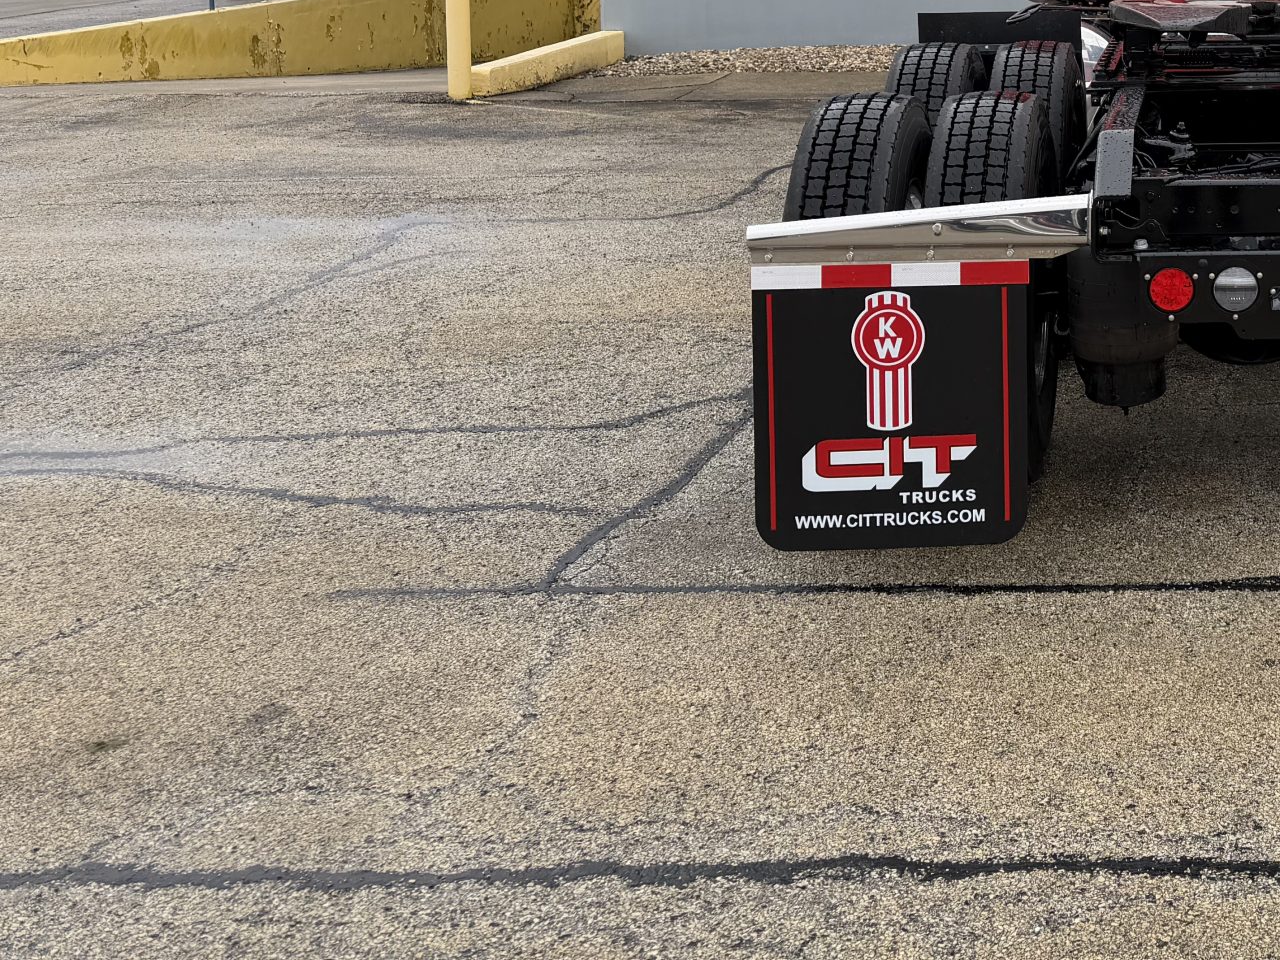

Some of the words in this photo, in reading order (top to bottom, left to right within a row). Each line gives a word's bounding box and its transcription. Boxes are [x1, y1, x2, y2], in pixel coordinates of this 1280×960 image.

[802, 434, 977, 492] CIT
[899, 489, 977, 504] TRUCKS
[795, 508, 986, 530] WWW.CITTRUCKS.COM
